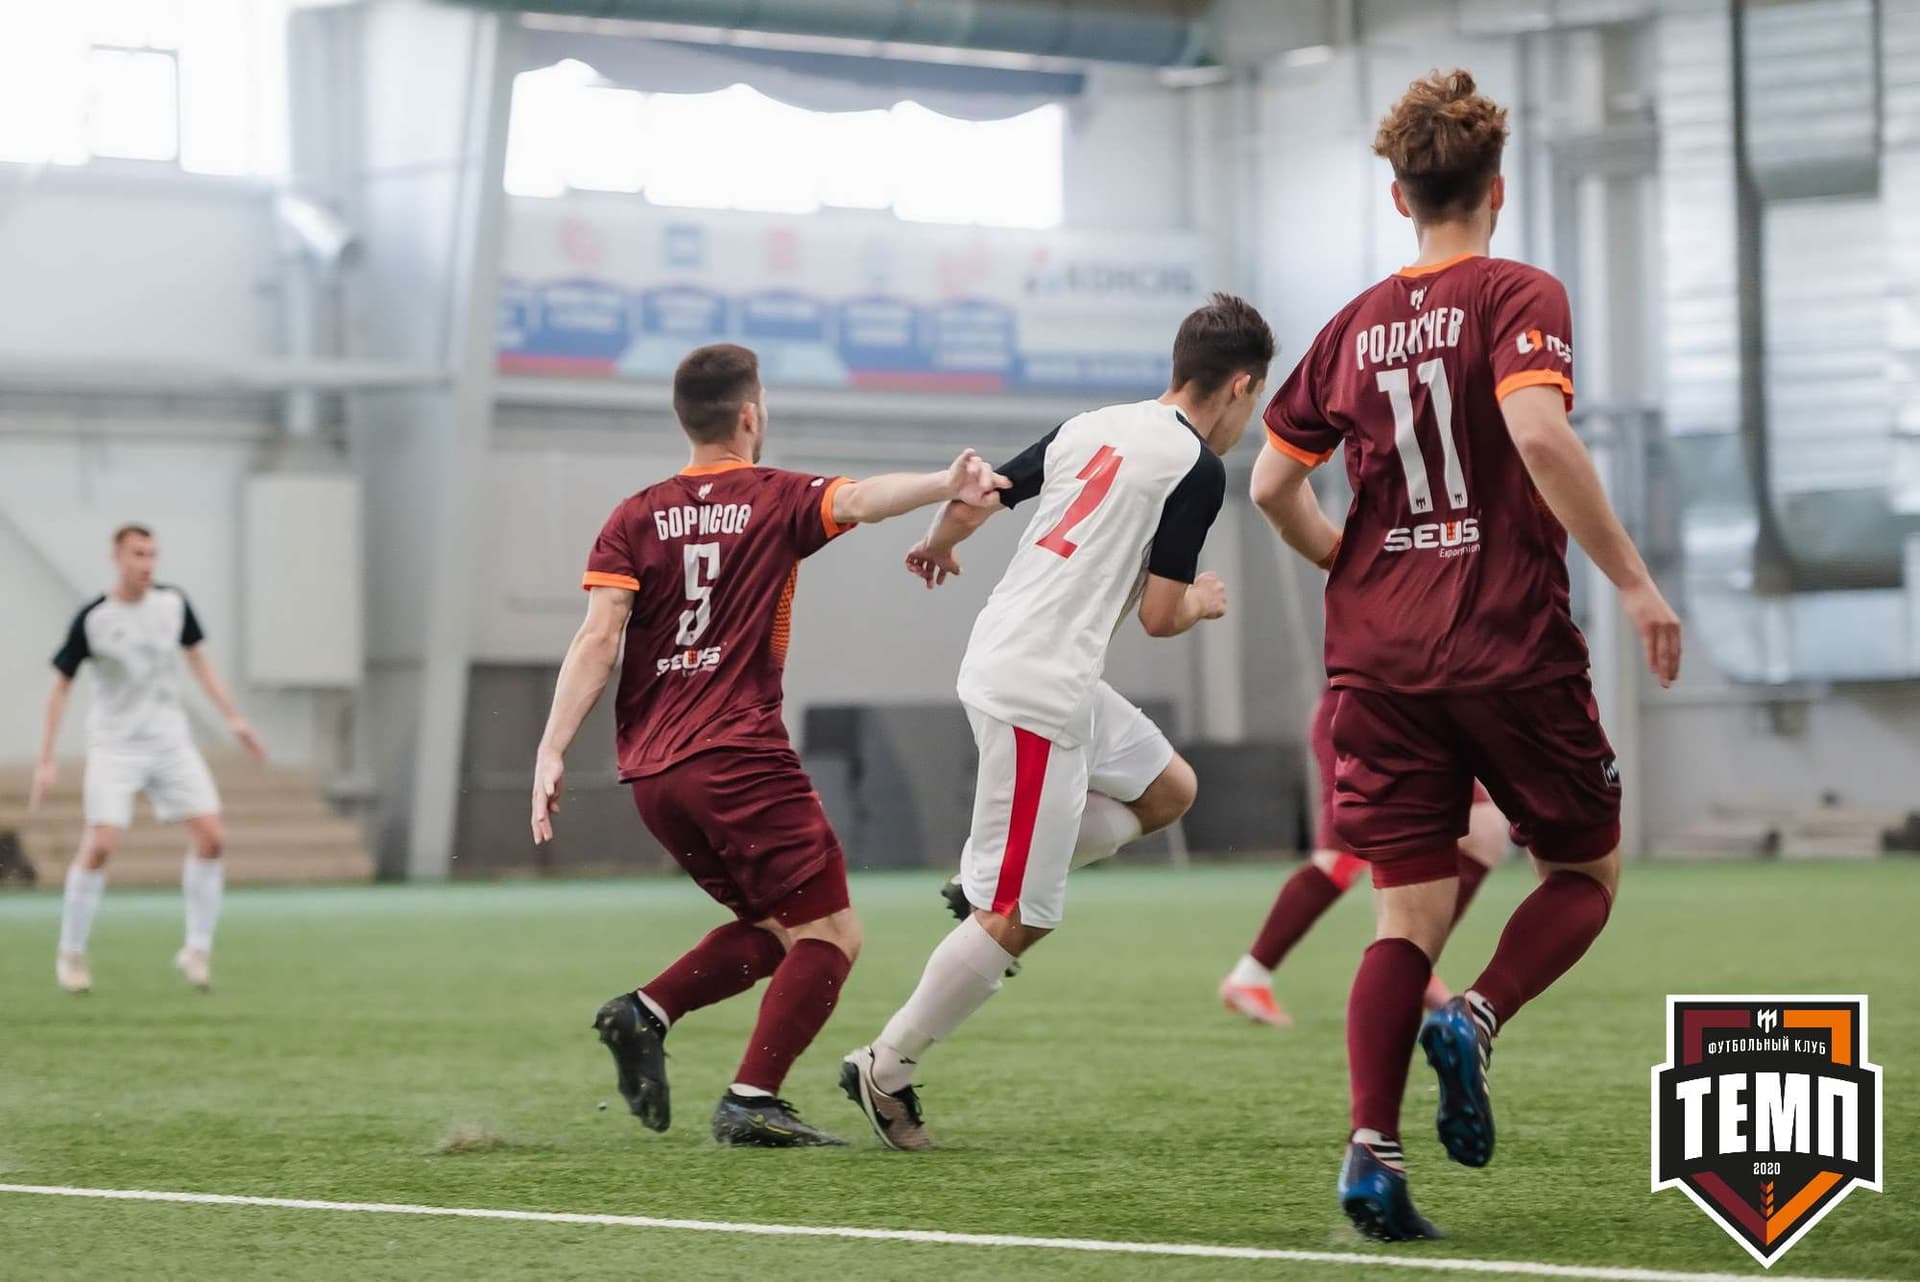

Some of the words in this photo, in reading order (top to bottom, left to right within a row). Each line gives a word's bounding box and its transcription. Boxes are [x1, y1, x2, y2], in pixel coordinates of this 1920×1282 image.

[1376, 356, 1468, 515] 11
[653, 503, 752, 541] БОРИСОВ
[1383, 518, 1480, 552] SEUS
[675, 541, 721, 646] 5
